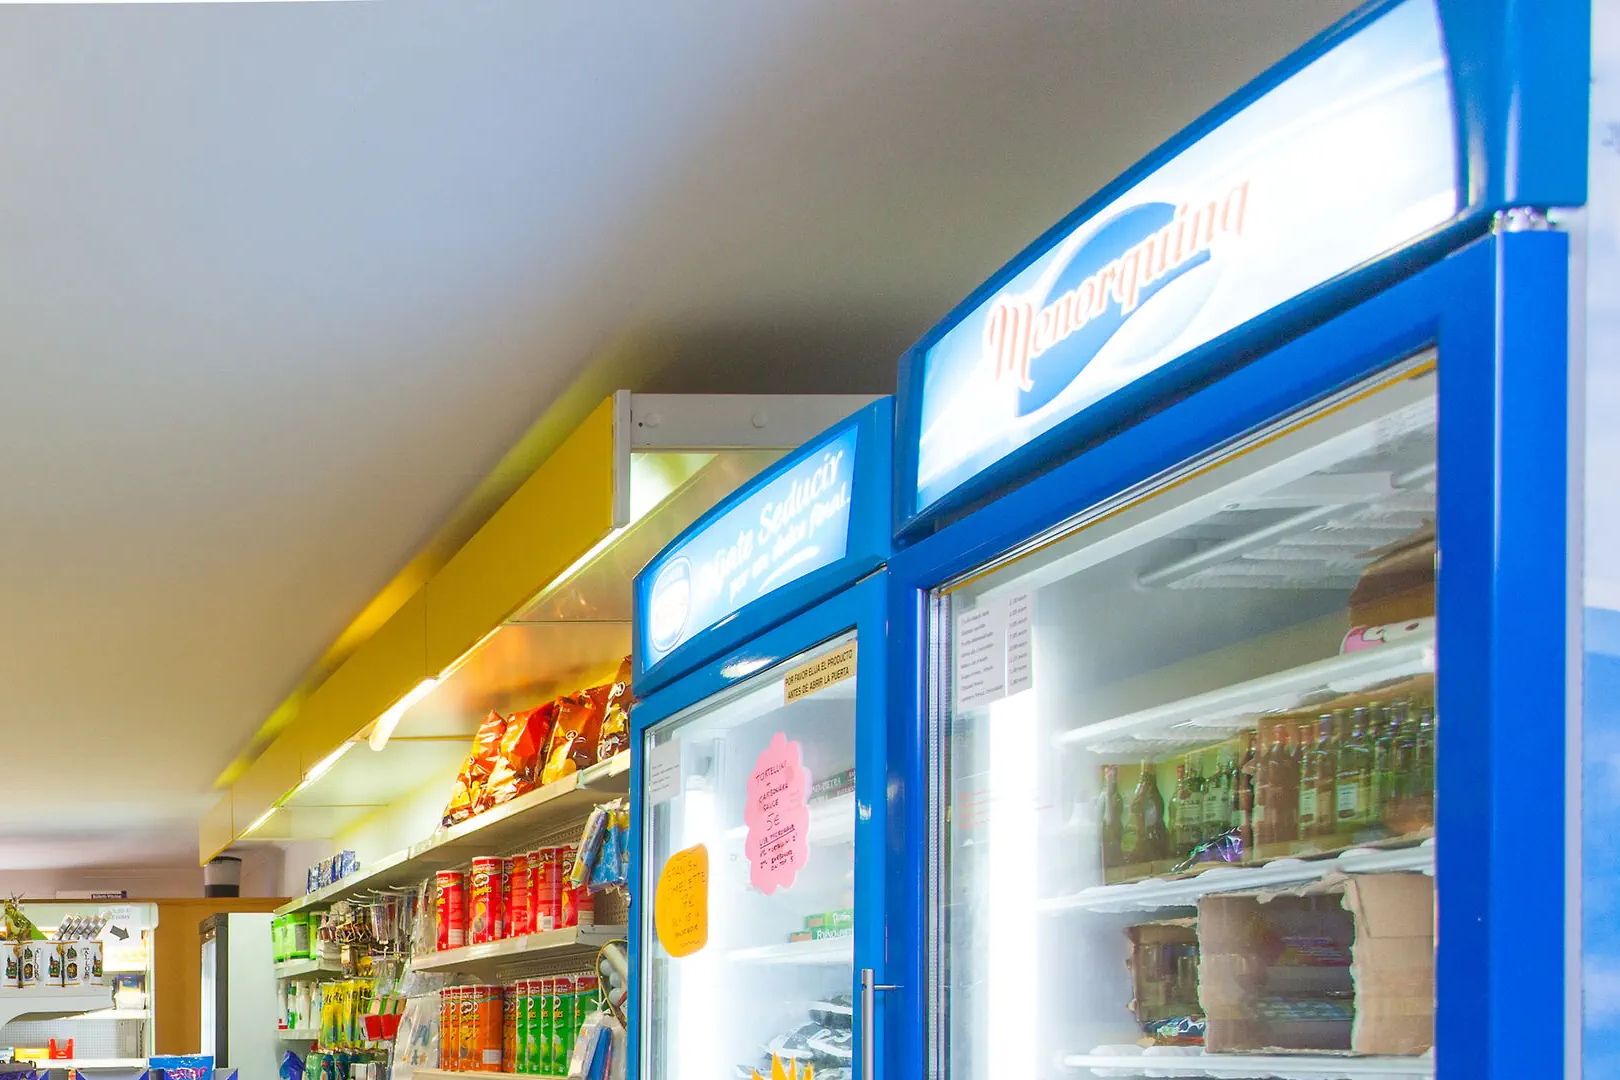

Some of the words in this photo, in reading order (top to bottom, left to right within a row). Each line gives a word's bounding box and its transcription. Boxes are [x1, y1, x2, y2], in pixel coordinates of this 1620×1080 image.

[794, 669, 808, 681] FAVOR
[827, 649, 853, 668] PRODUCTO
[788, 686, 802, 699] ANTES
[802, 683, 809, 694] DE
[831, 666, 849, 681] PUERTA
